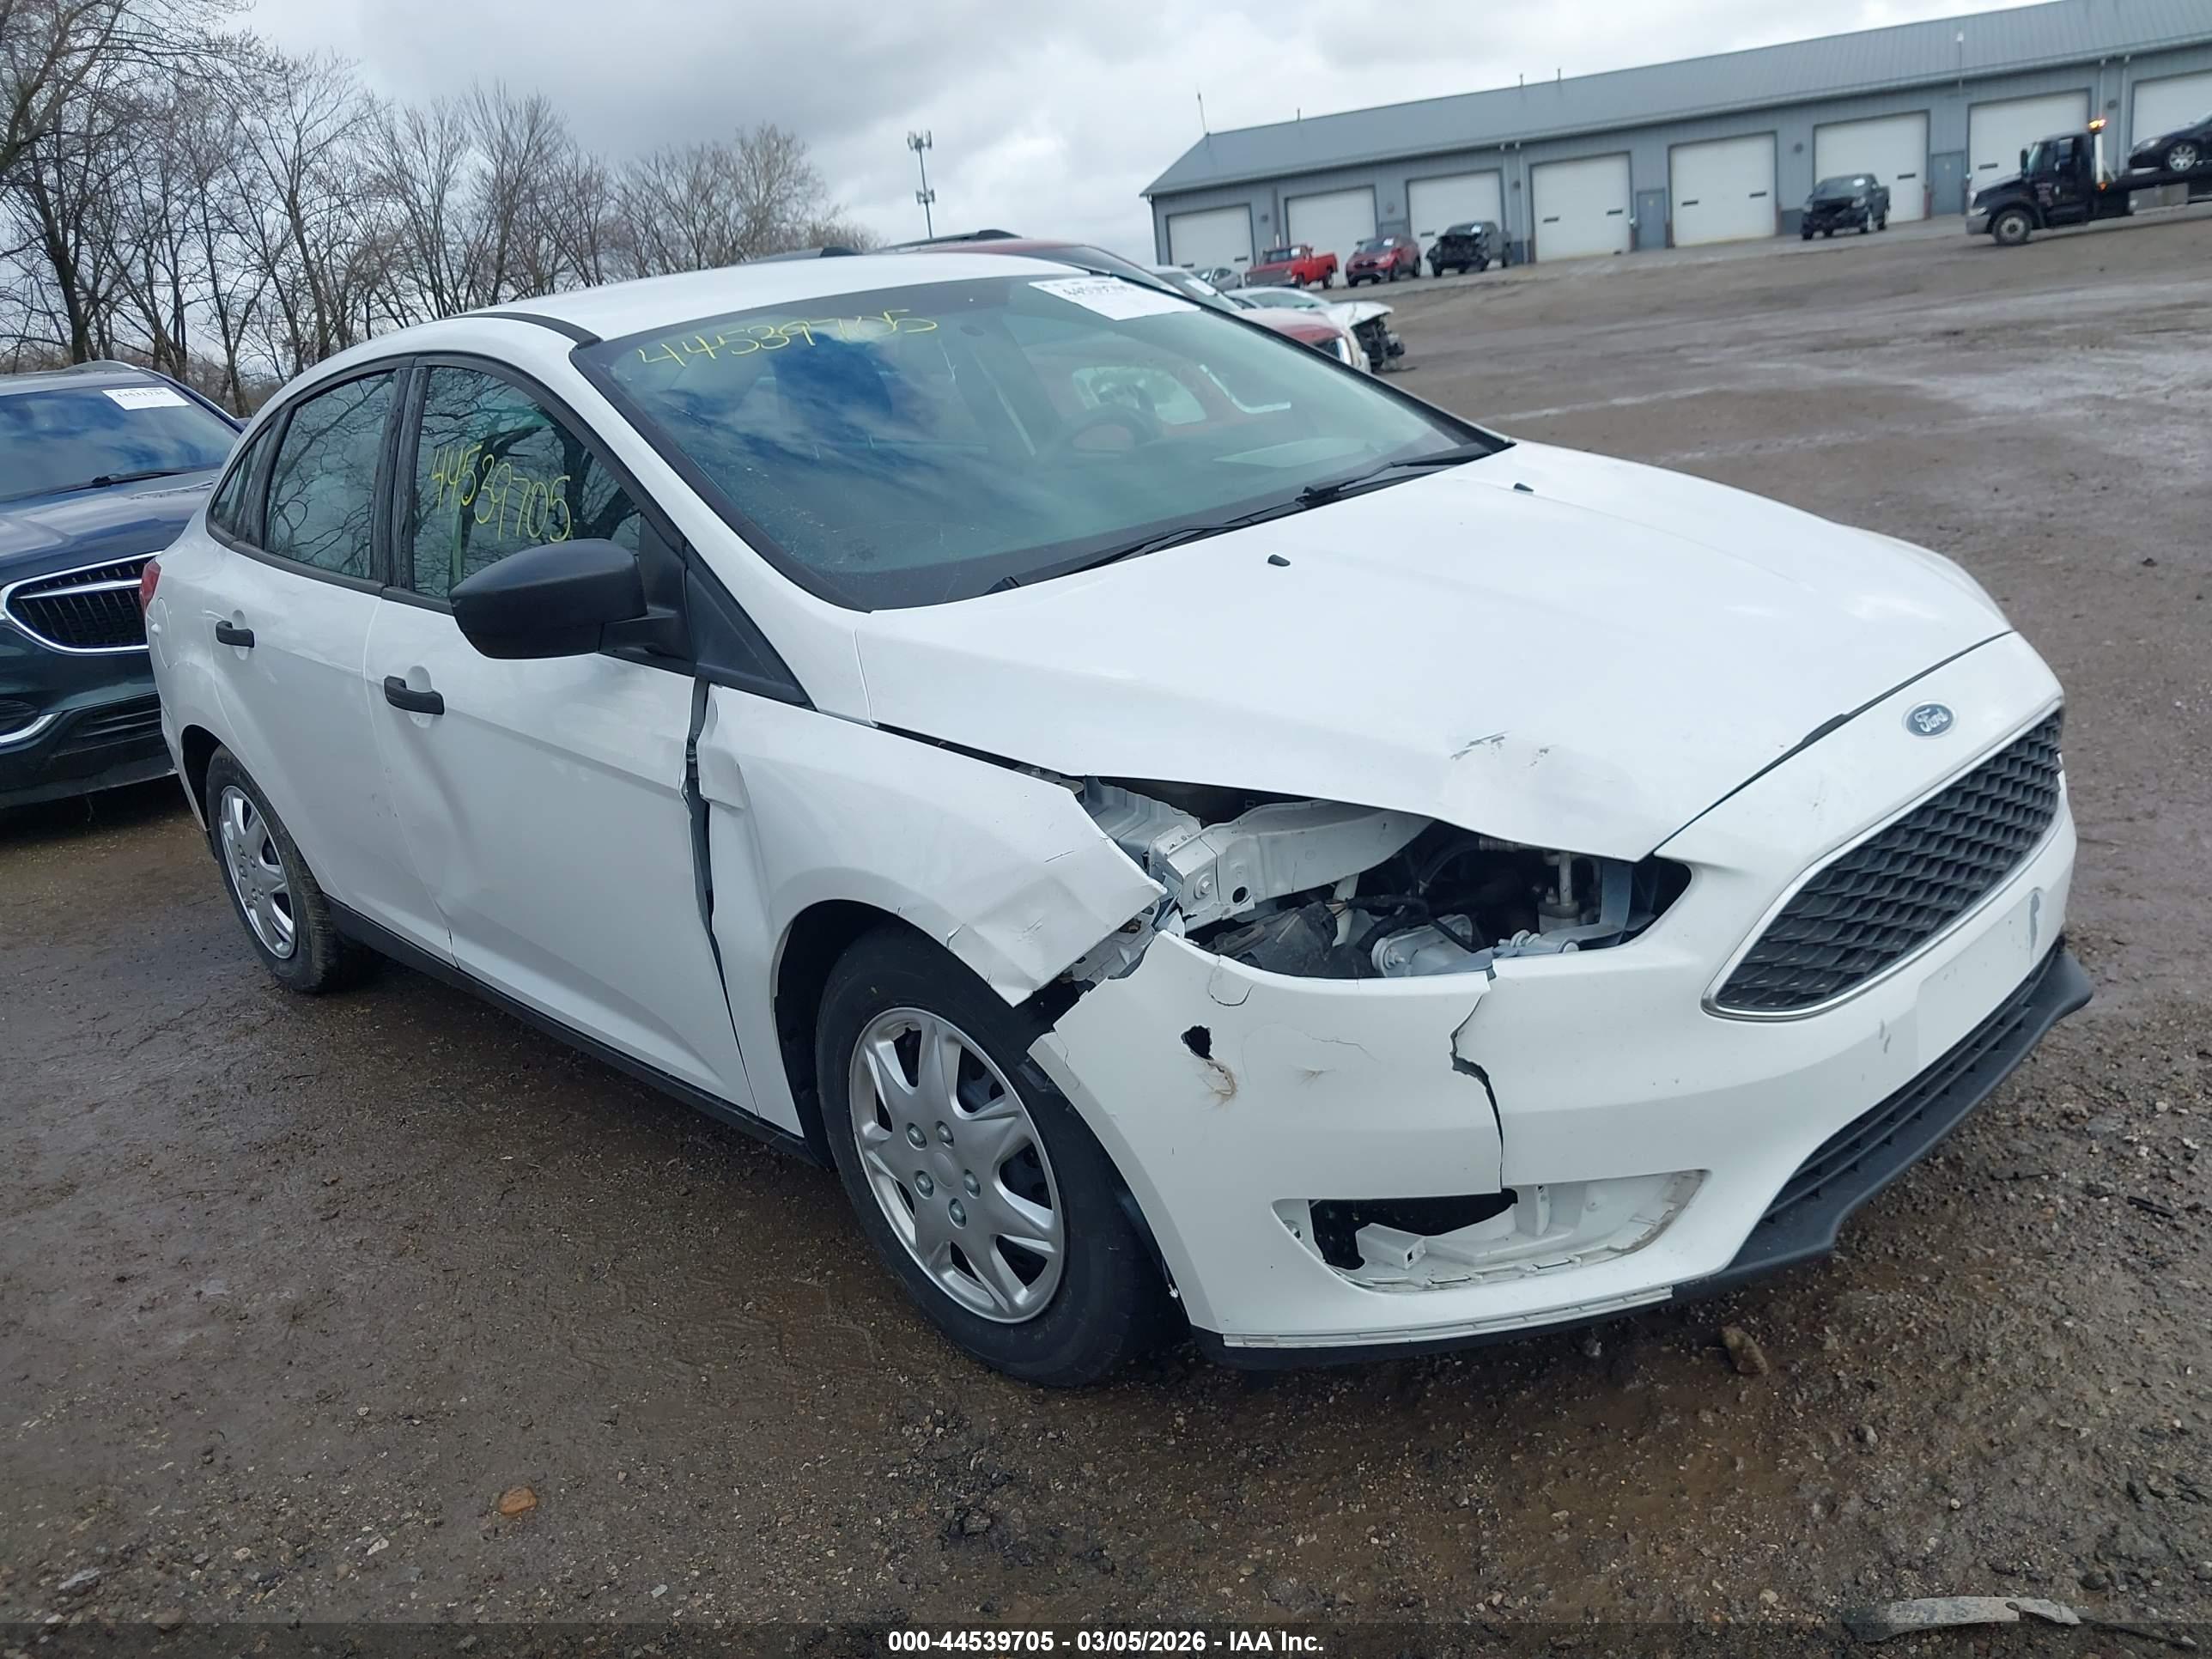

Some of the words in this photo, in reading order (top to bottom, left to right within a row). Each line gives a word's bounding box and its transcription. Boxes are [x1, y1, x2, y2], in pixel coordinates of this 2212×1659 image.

[638, 308, 939, 368] 44539705
[431, 443, 571, 543] 44539705
[1913, 708, 1949, 733] Ford
